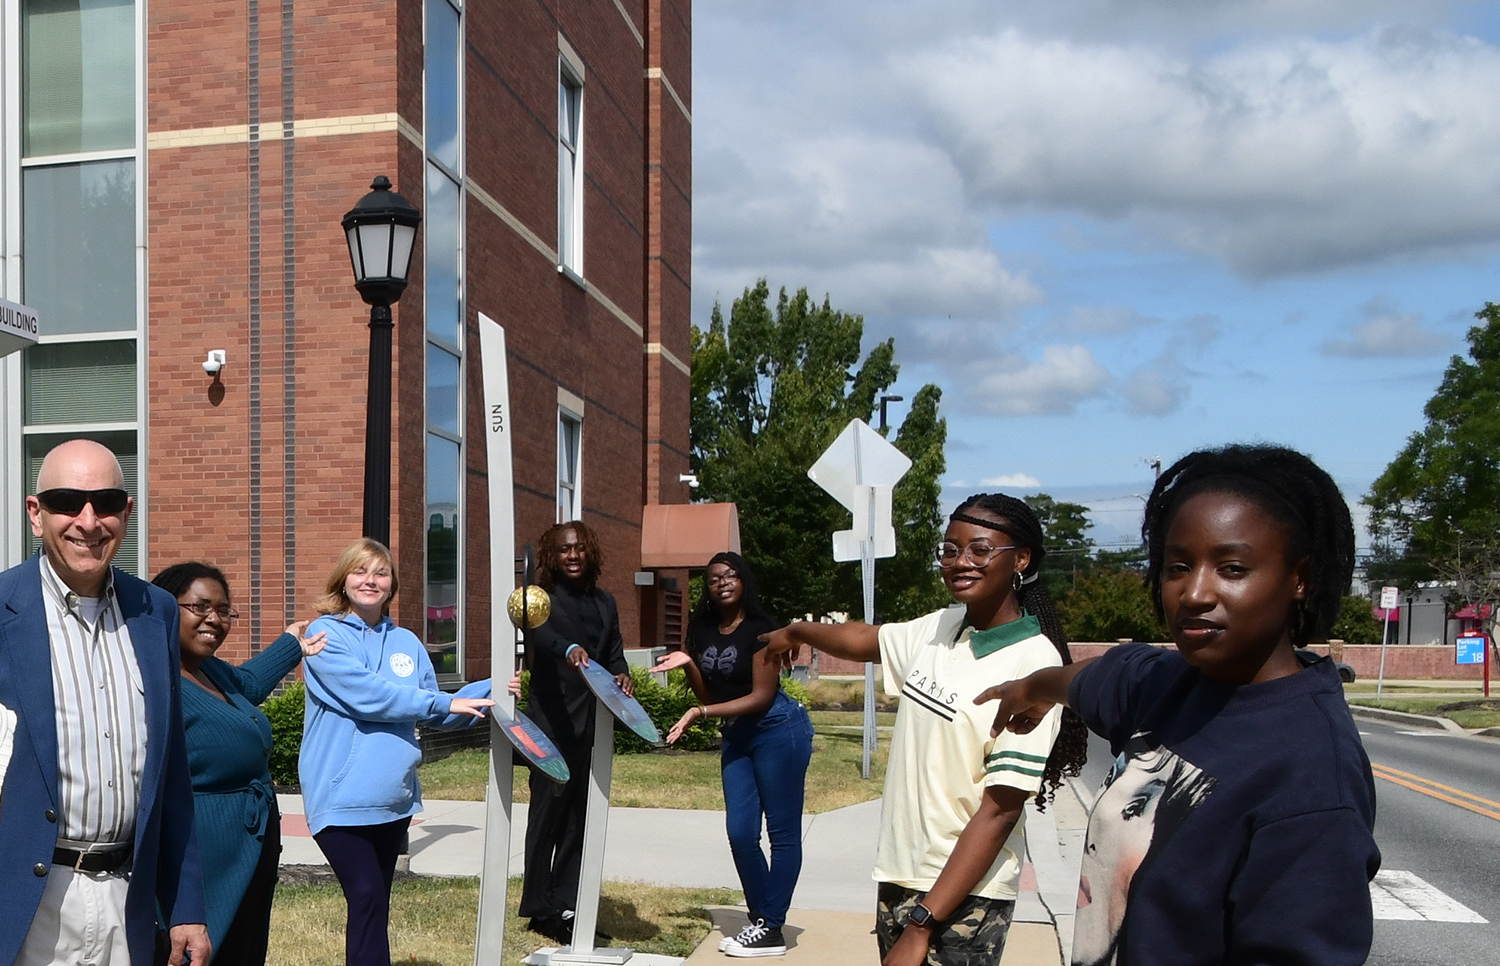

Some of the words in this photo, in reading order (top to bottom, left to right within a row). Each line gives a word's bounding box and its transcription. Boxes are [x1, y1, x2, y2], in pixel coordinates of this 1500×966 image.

[492, 404, 504, 432] SUN
[1472, 652, 1484, 663] 18
[908, 669, 958, 705] PARIS
